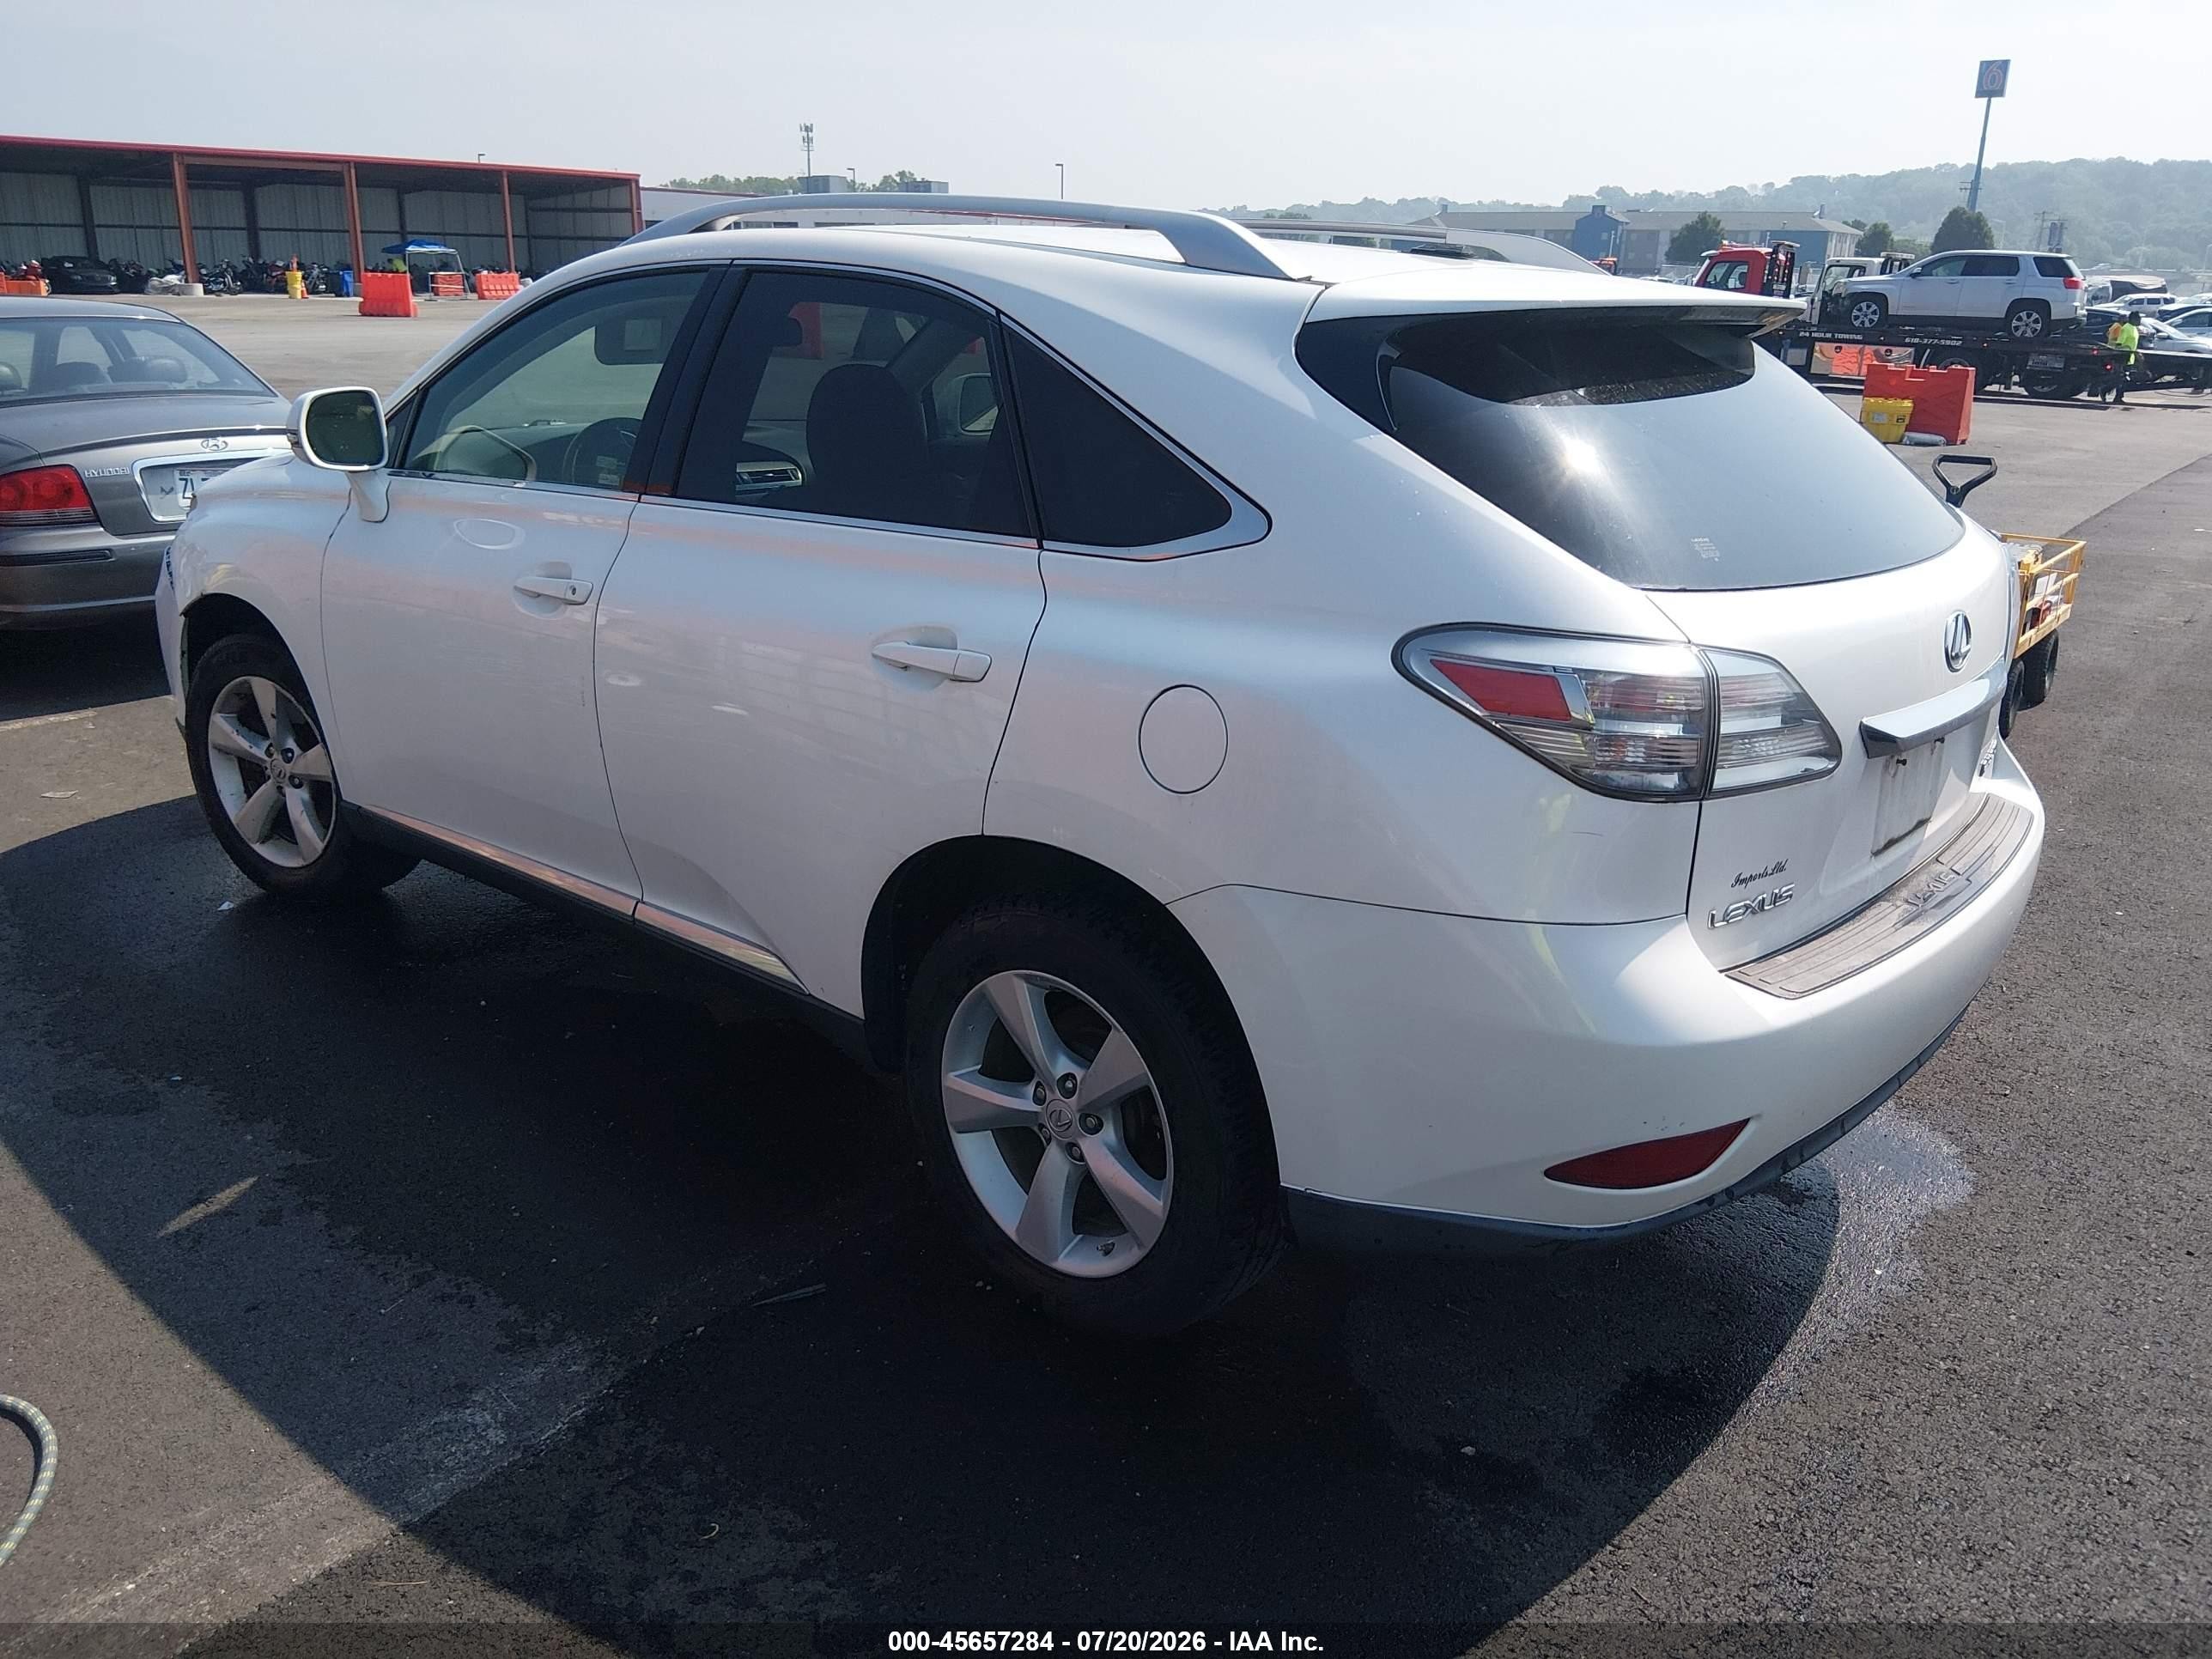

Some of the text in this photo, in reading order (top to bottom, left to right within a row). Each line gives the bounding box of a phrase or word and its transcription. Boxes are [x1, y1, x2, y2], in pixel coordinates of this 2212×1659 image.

[84, 466, 131, 477] HYUNDAI
[1730, 865, 1769, 889] Imports
[1905, 872, 1956, 908] LEXUS
[1707, 882, 1796, 929] LEXUS
